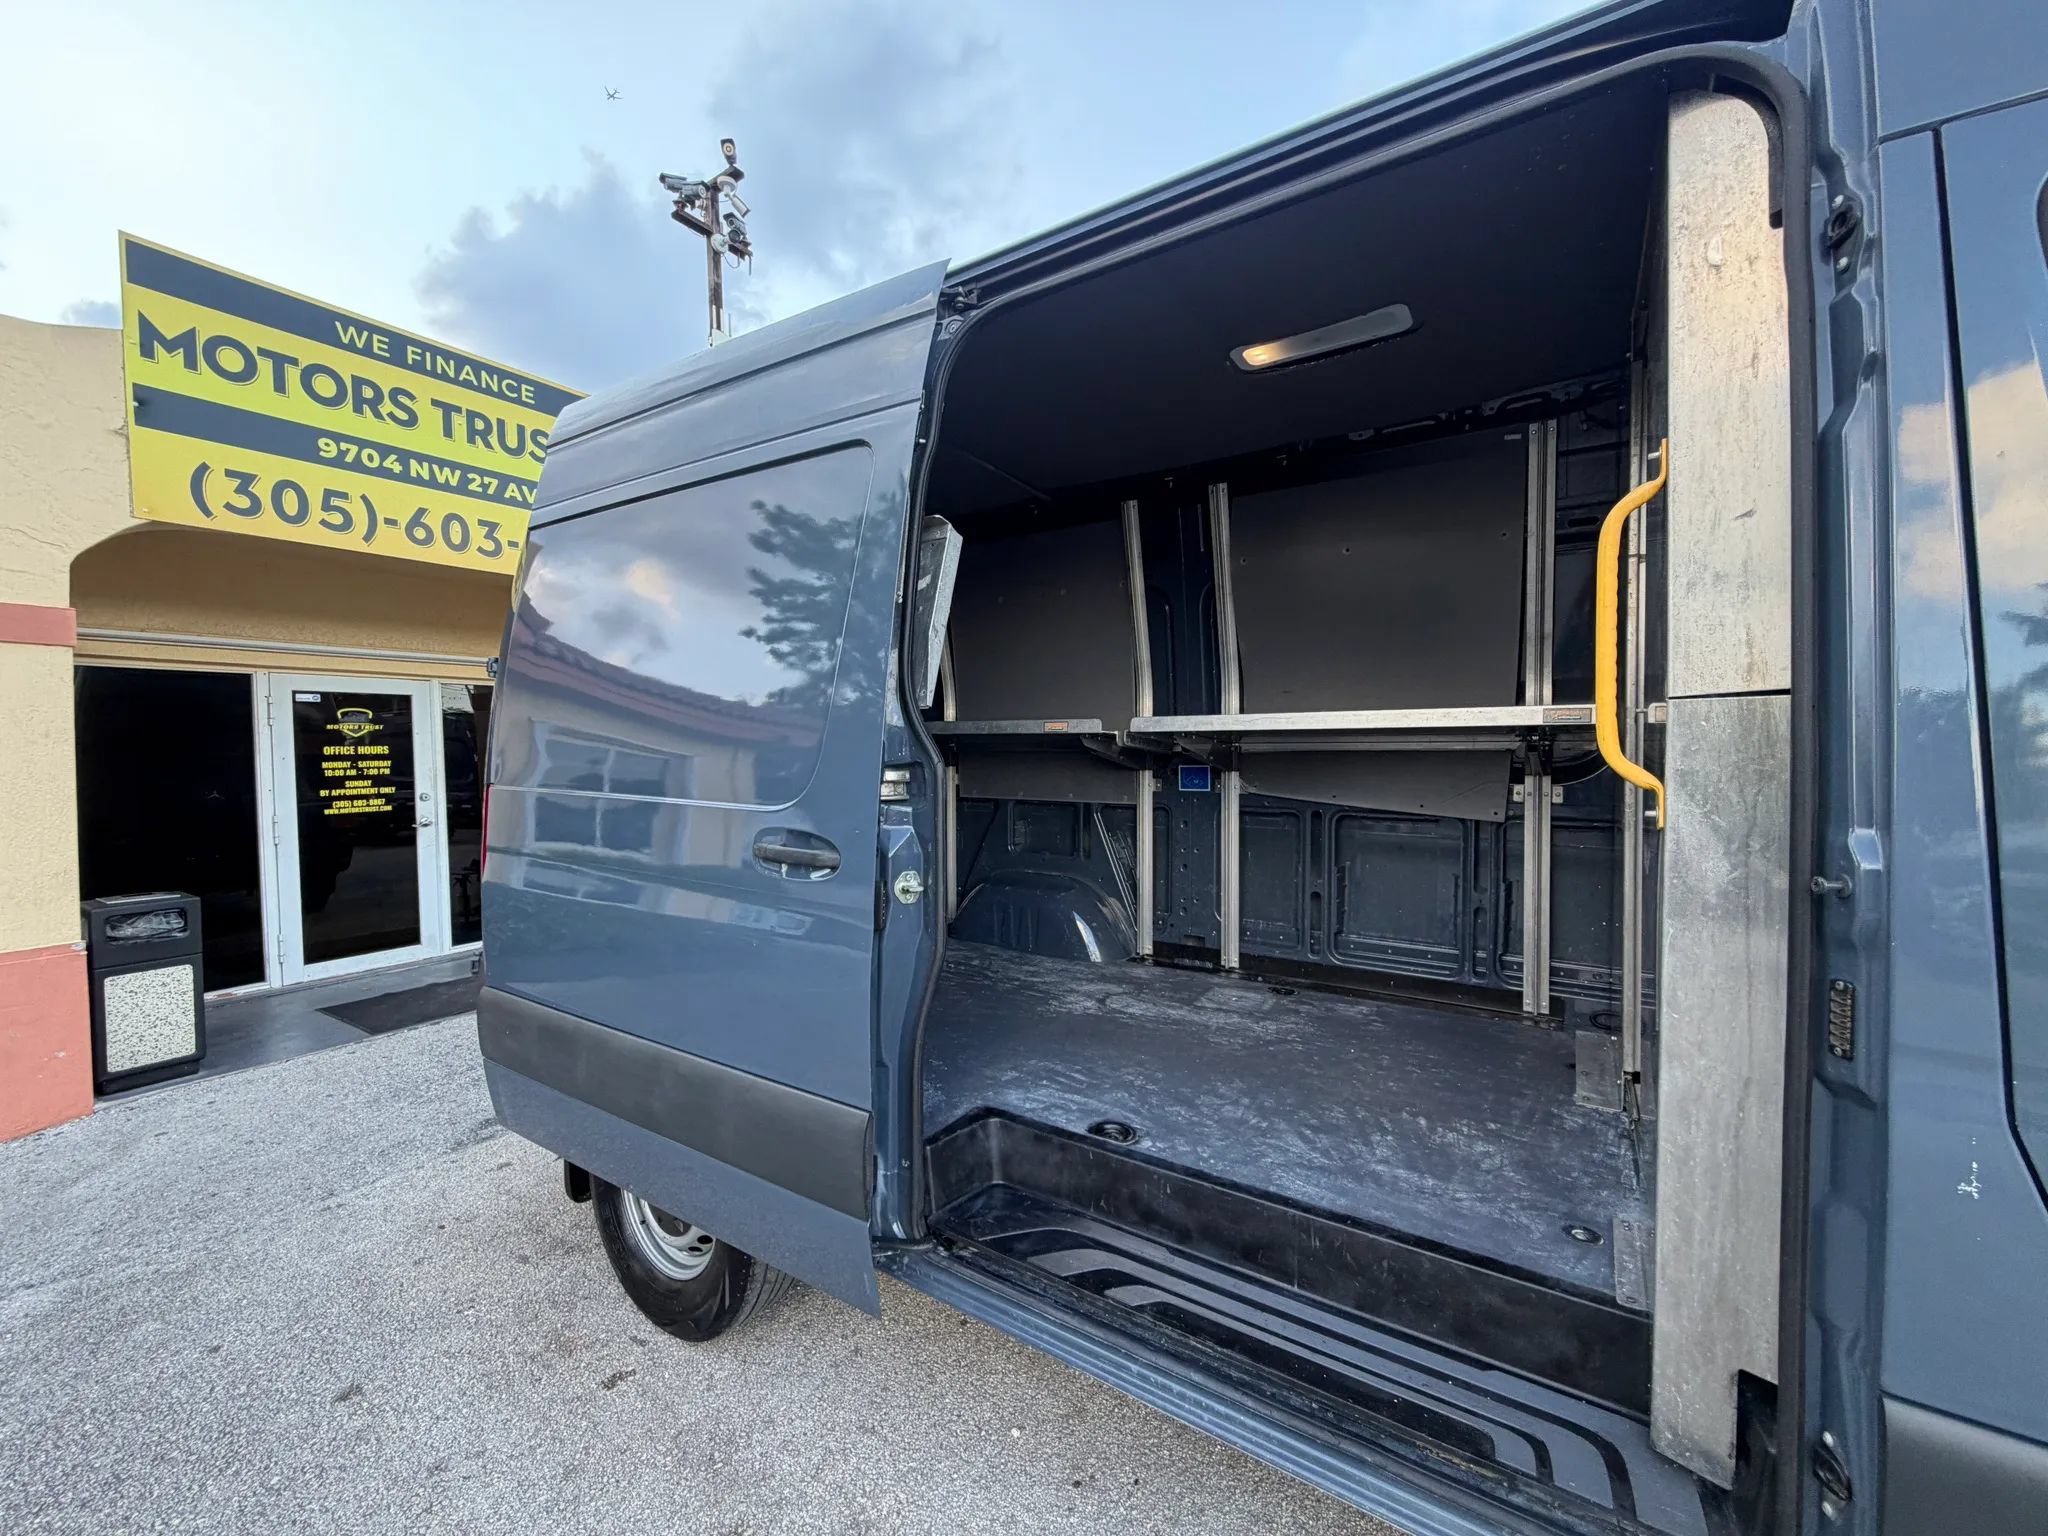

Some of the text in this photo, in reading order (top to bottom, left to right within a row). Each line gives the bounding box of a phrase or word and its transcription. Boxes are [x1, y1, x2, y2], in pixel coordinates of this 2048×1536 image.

[334, 320, 536, 405] WE FINANCE
[137, 309, 549, 466] MOTORS TRUS
[316, 437, 404, 475] 9704
[408, 458, 462, 488] NW
[467, 472, 500, 496] 27
[323, 745, 390, 755] OFFICE HOURS
[321, 761, 351, 769] MONDAY
[357, 760, 392, 768] SATURDAY
[324, 769, 345, 777] 10:00
[379, 767, 391, 775] PM
[344, 780, 372, 788] SUNDAY
[331, 787, 378, 796] APPOINTMENT
[379, 786, 396, 794] ONLY
[332, 800, 352, 809] (305)
